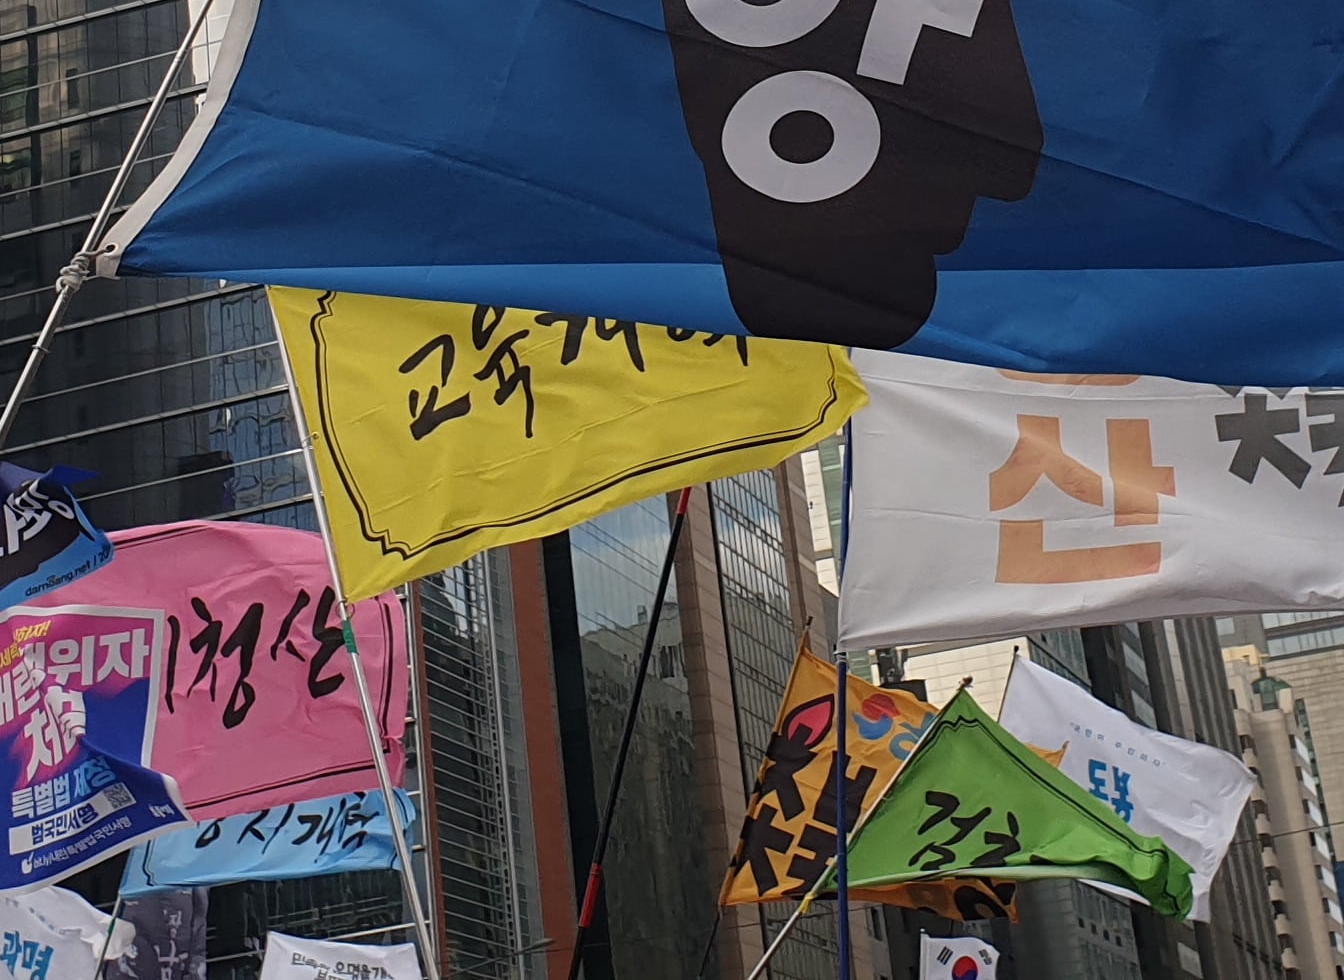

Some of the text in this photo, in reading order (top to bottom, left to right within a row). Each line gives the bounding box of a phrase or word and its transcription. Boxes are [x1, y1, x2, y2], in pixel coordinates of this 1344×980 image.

[989, 413, 1176, 585] 산
[11, 772, 72, 819] 특별법
[0, 930, 55, 980] 광명
